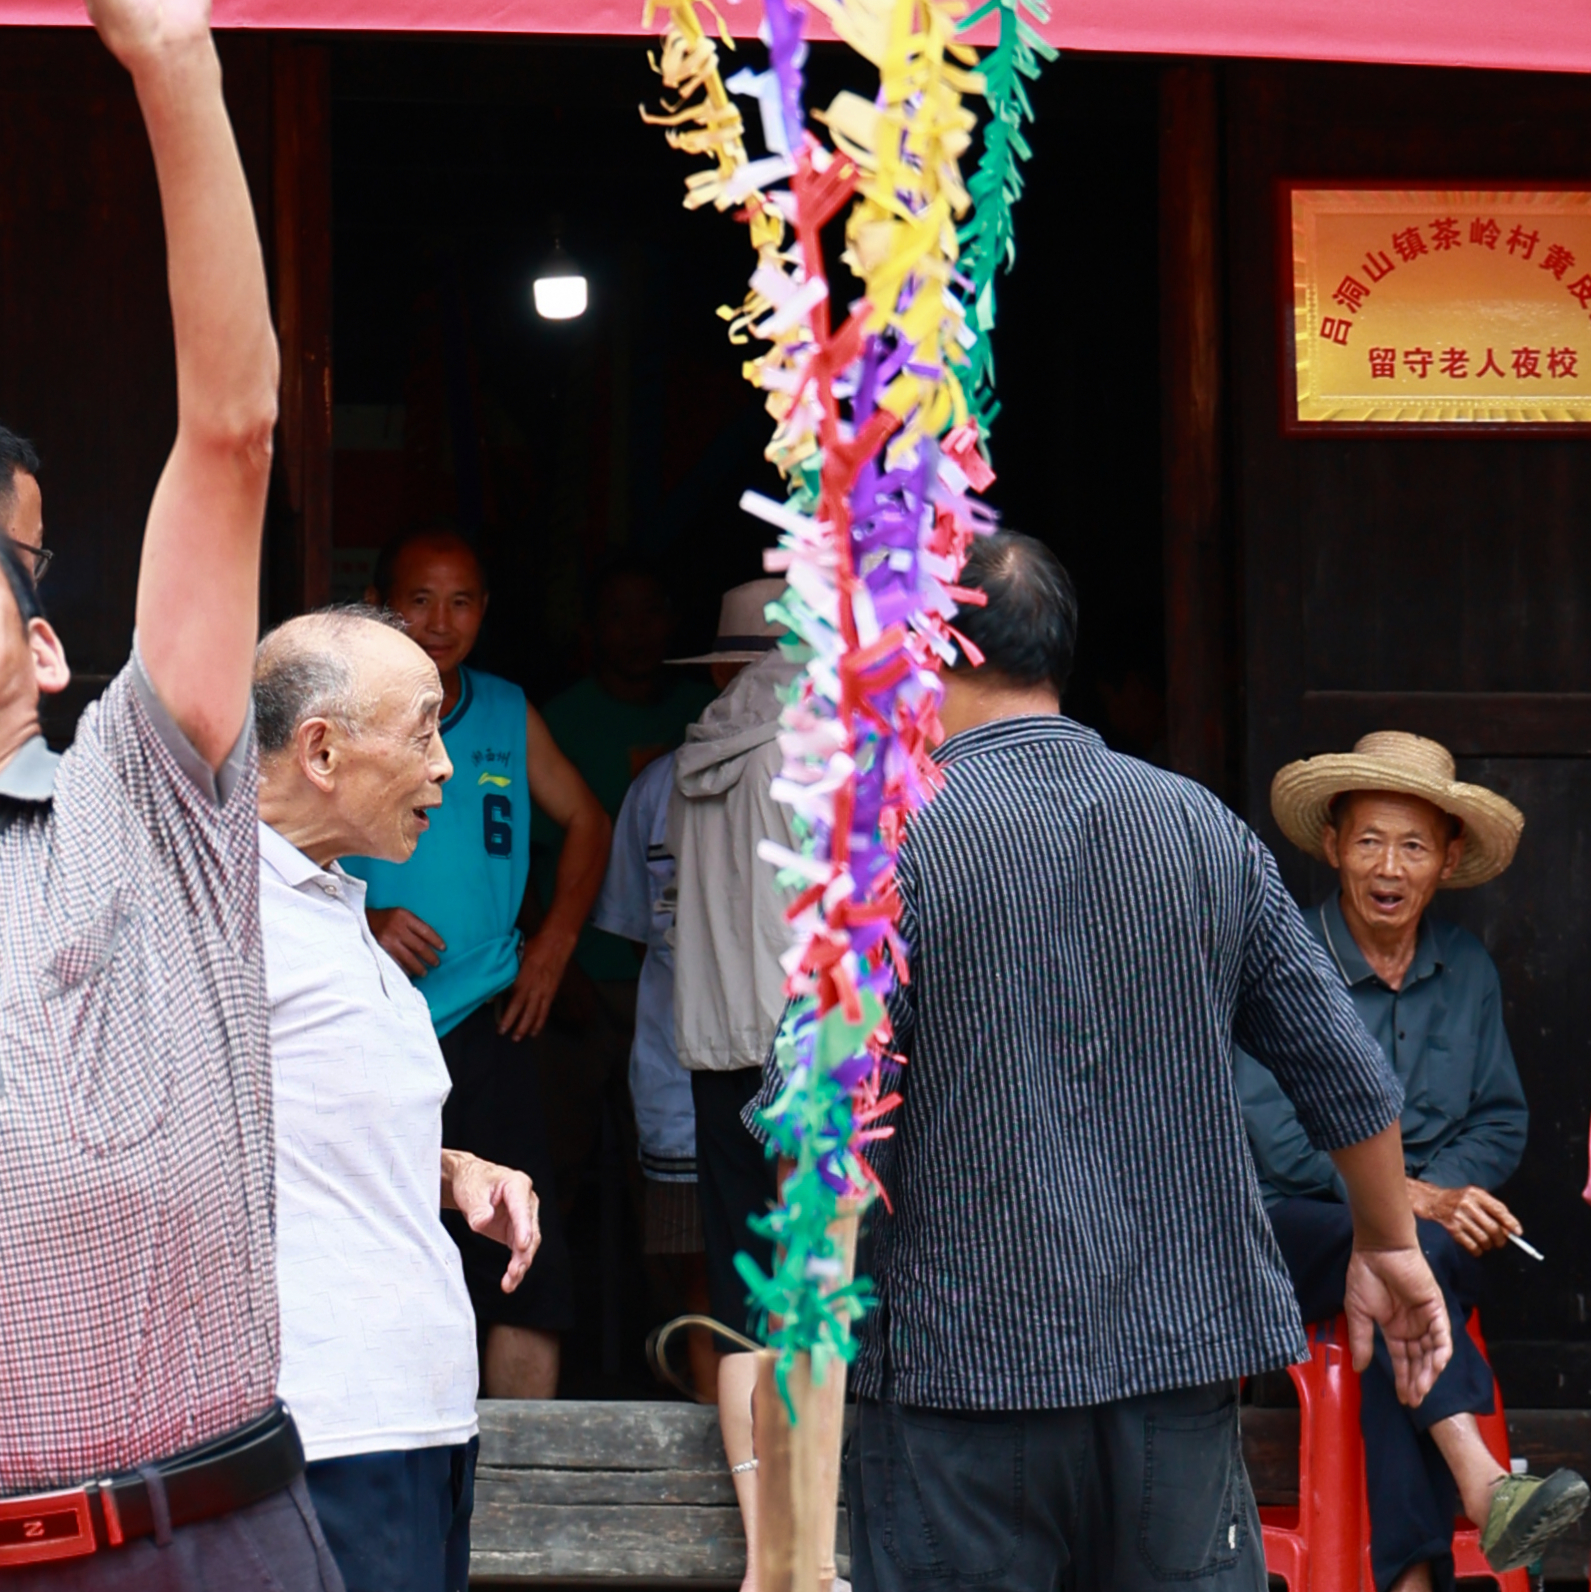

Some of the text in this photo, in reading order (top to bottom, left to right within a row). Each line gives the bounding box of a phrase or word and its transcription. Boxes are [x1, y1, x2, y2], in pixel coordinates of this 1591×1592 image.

[1367, 346, 1579, 380] 留守老人夜校
[482, 793, 513, 858] 6
